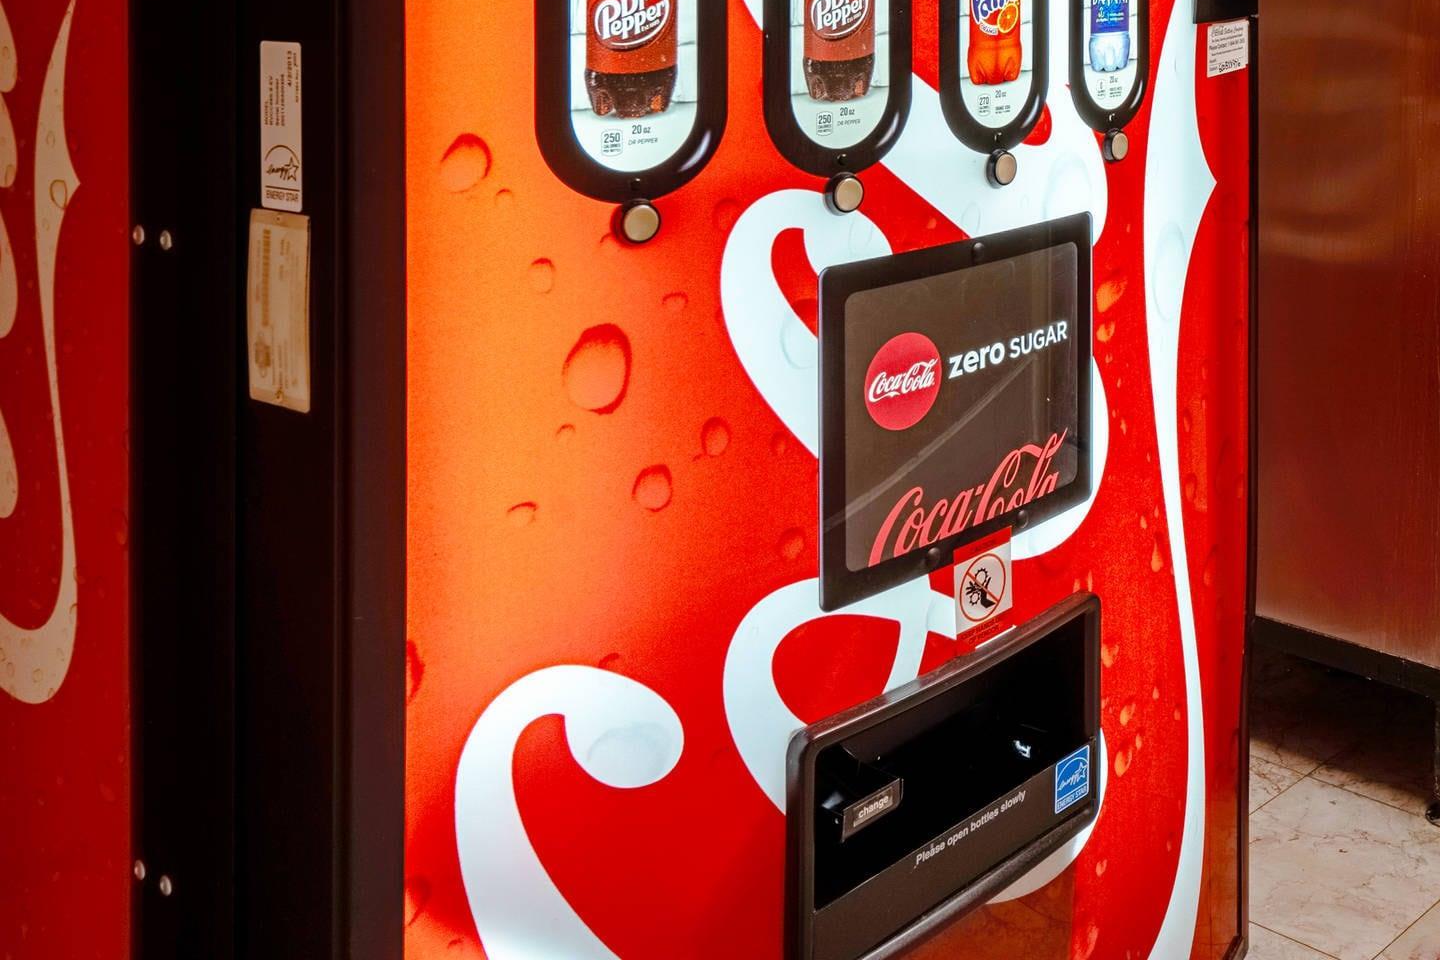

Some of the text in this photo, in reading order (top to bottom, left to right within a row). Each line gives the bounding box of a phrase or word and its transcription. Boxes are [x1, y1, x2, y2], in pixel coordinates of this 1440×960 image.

[818, 114, 831, 125] 250
[840, 106, 849, 117] 20
[603, 132, 621, 144] 250
[631, 124, 642, 135] 20
[948, 320, 1068, 380] zero SUGAR
[868, 357, 938, 403] Coca-Cola
[858, 795, 889, 819] change
[916, 790, 1026, 865] Please open bottles slowly
